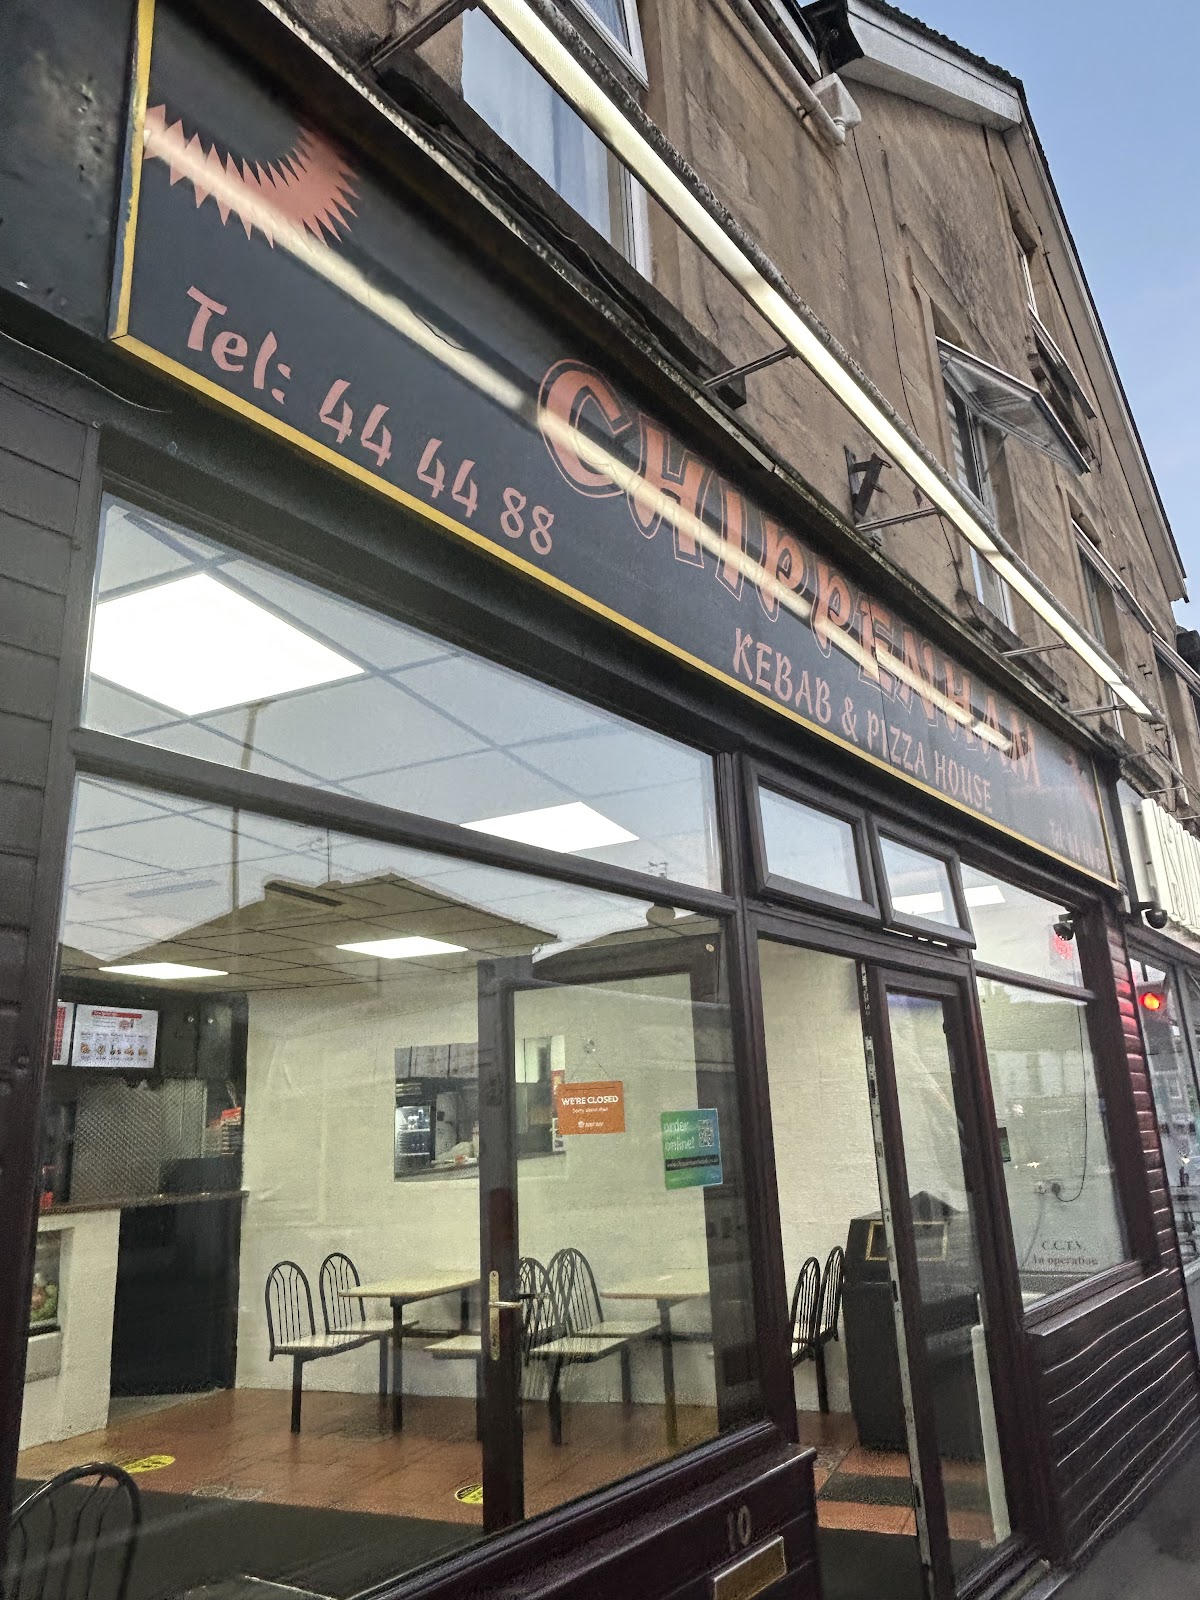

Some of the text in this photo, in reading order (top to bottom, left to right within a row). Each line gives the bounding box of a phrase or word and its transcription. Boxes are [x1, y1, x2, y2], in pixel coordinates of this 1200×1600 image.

[187, 285, 554, 555] Tel: 44 44 88
[537, 358, 1041, 788] CHIPPENHAM
[733, 627, 993, 814] KEBAB & PIZZA HOUSE
[561, 1095, 619, 1106] WE'RE CLOSED
[727, 1504, 752, 1553] 10
